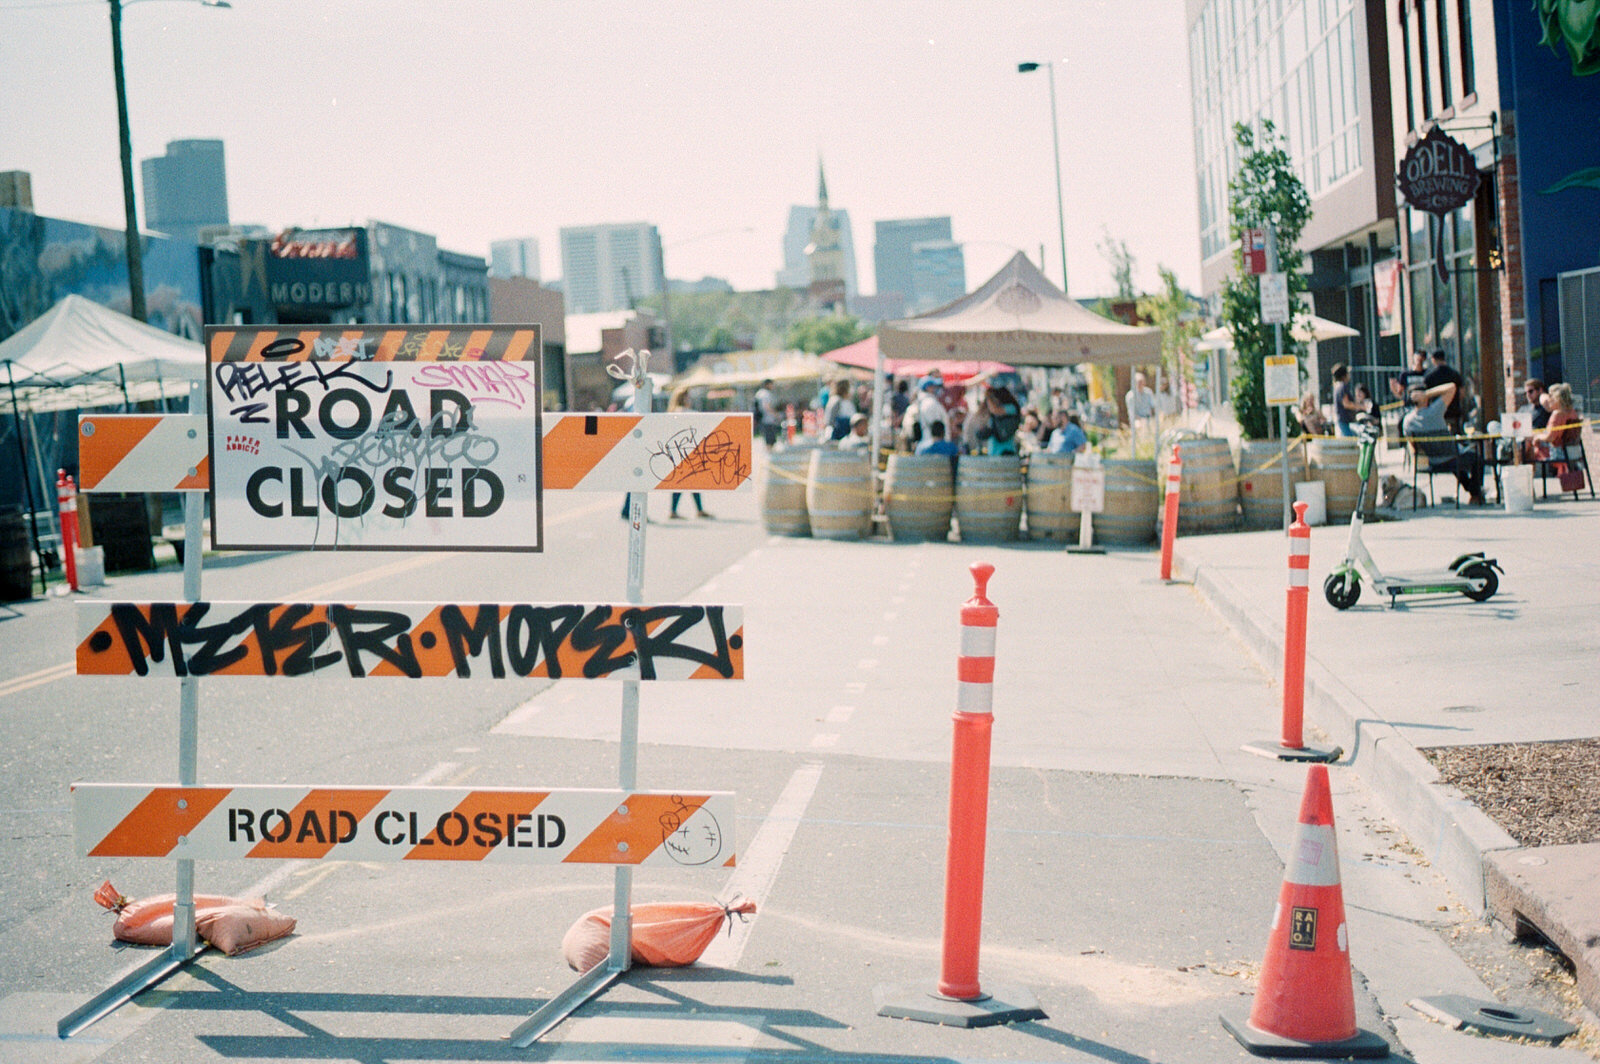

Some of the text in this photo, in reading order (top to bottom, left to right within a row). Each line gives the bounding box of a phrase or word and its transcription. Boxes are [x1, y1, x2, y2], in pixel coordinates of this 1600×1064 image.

[1407, 140, 1471, 182] ODELL
[1408, 177, 1469, 198] BREWING
[270, 281, 369, 304] MODERN
[275, 387, 475, 440] ROAD
[226, 434, 261, 448] PAPER
[226, 442, 260, 456] ADDICTS
[245, 465, 506, 519] CLOSED
[228, 807, 567, 849] ROAD CLOSED
